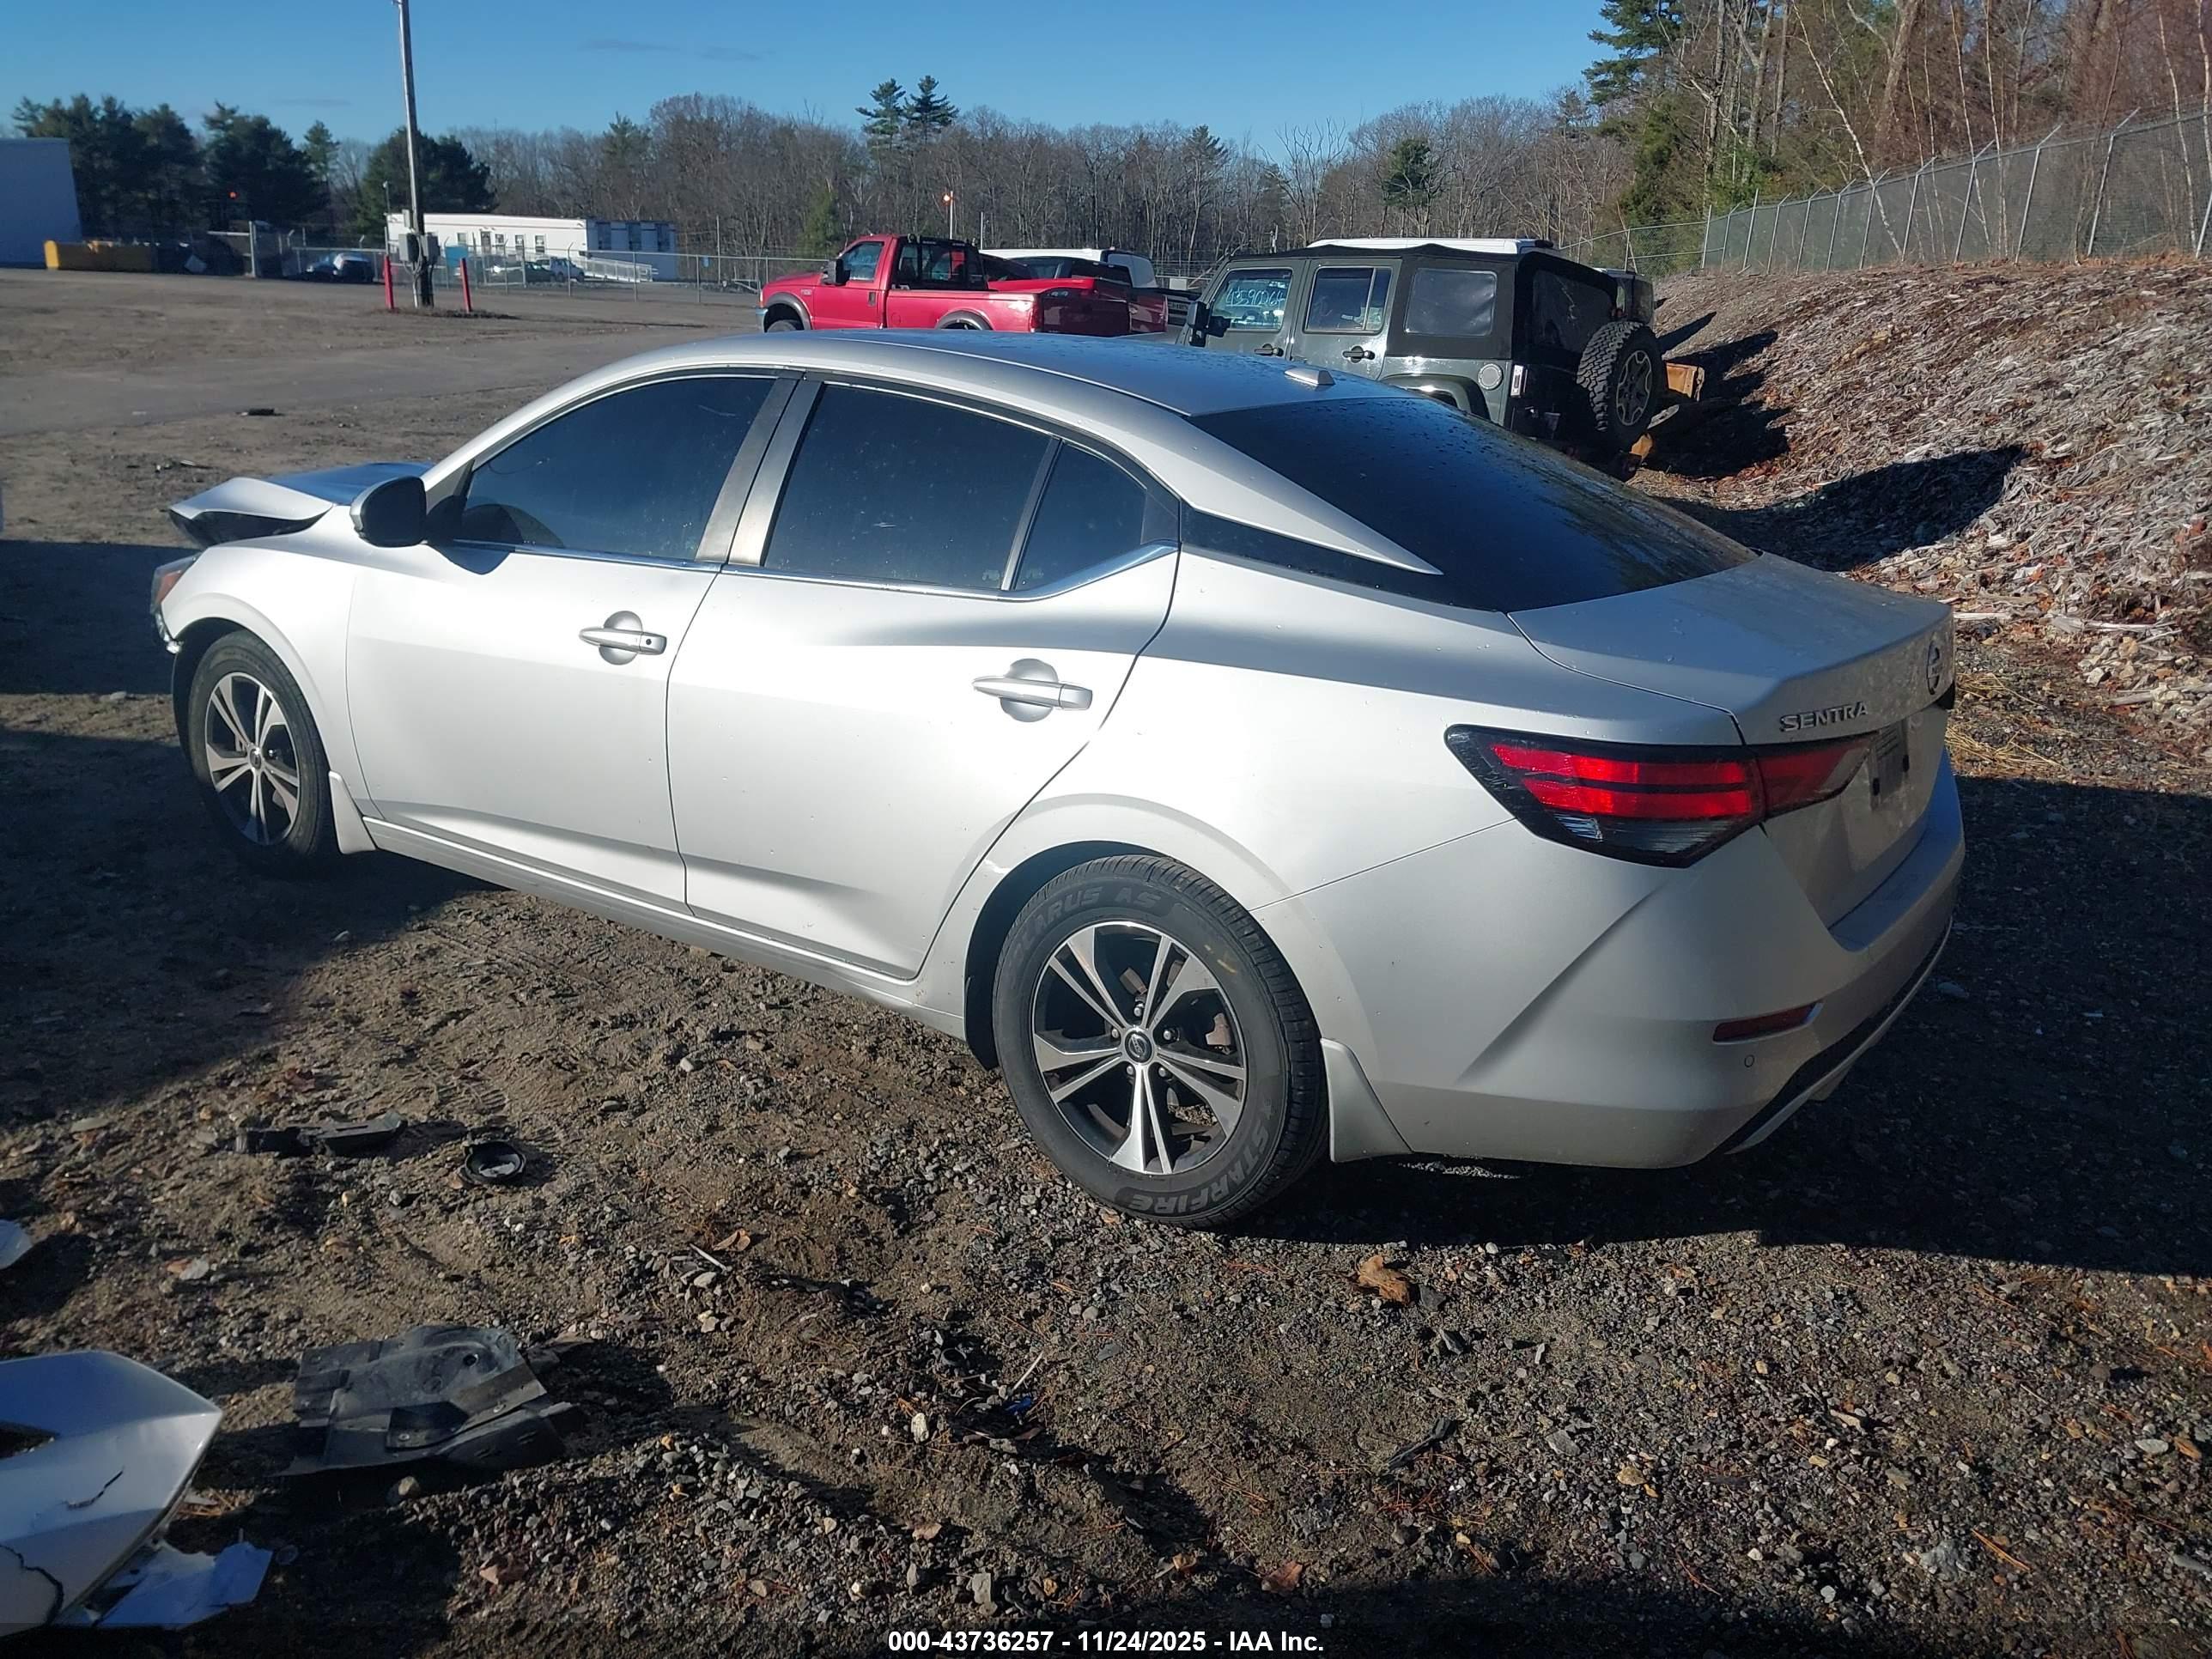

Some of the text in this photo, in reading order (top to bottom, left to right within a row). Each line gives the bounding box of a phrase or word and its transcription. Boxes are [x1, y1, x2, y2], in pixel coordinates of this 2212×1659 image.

[1779, 701, 1869, 732] SENTRA
[1116, 886, 1161, 910] AS
[1130, 1124, 1269, 1215] STARFIRE
